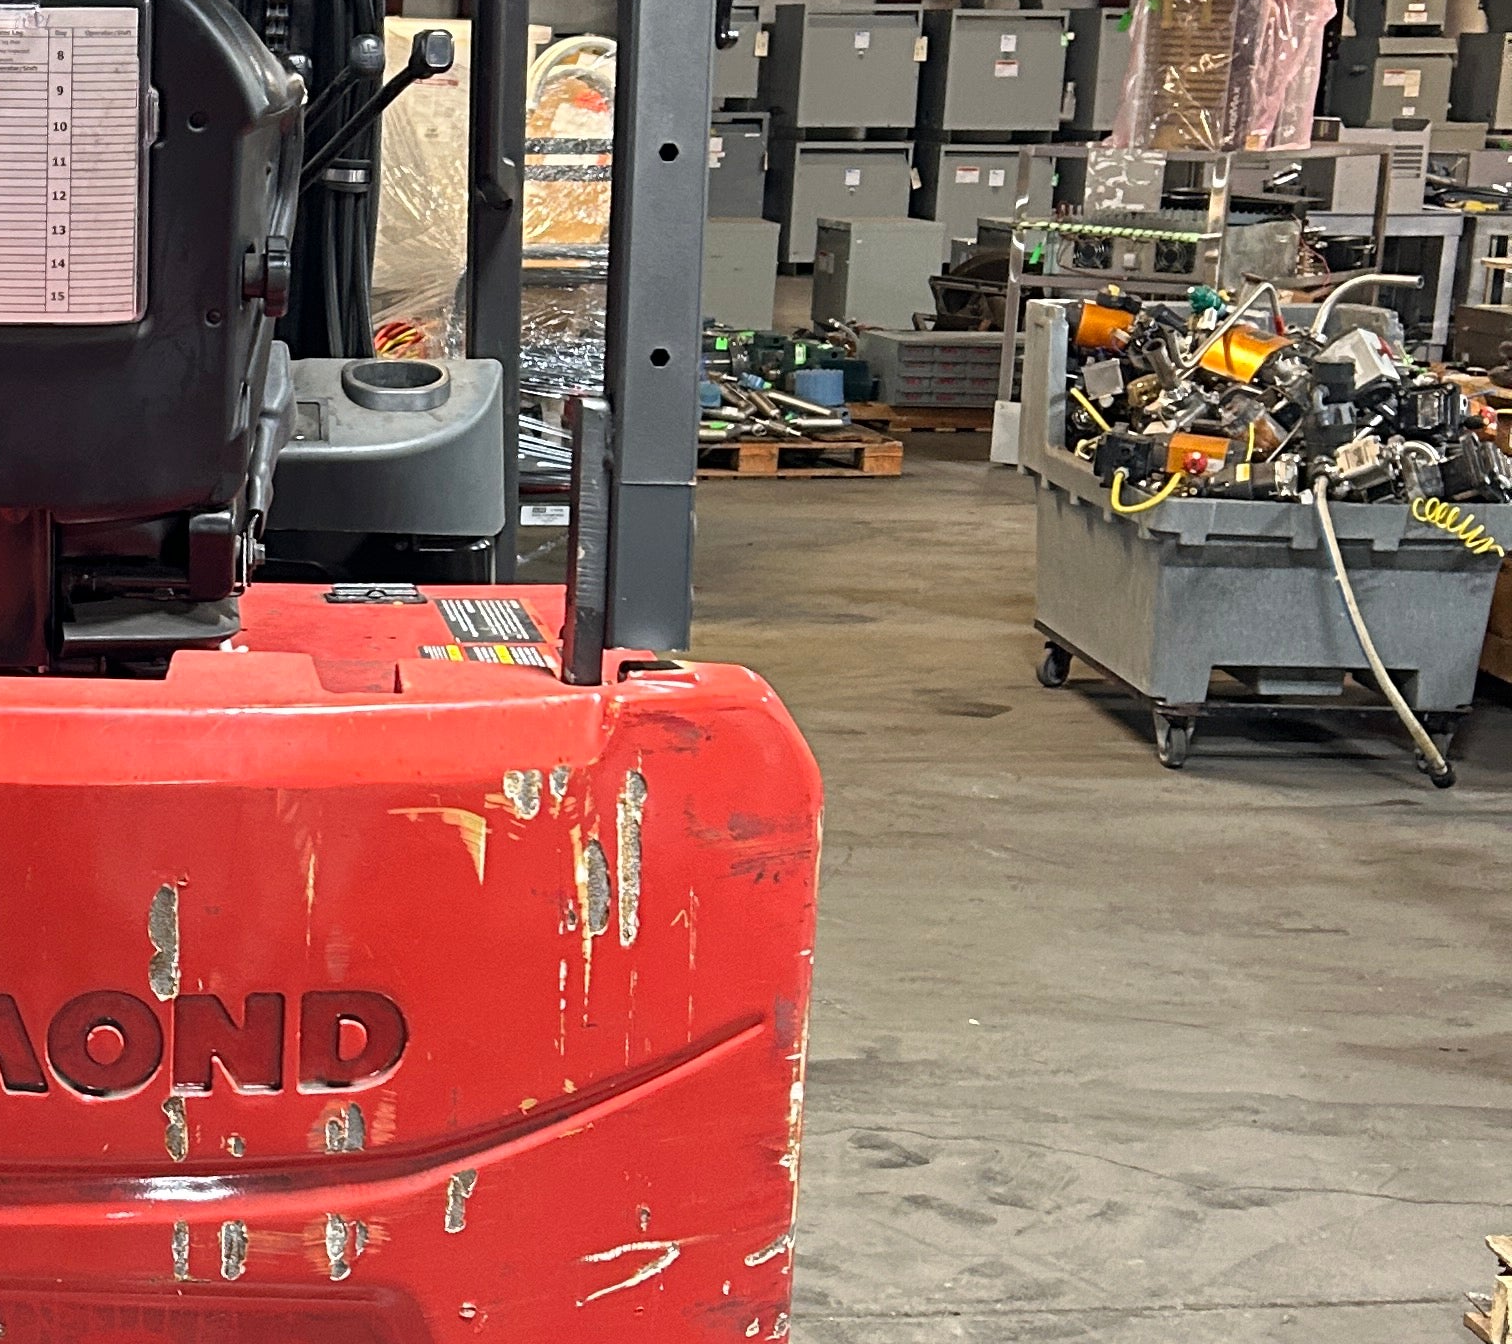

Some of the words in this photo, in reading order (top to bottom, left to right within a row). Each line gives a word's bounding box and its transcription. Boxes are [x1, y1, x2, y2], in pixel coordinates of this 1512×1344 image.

[56, 50, 65, 61] 8
[56, 85, 64, 96] 9
[53, 121, 68, 132] 10
[52, 157, 67, 167] 11
[52, 191, 67, 201] 12
[51, 225, 66, 235] 13
[51, 259, 65, 269] 14
[50, 291, 65, 301] 15
